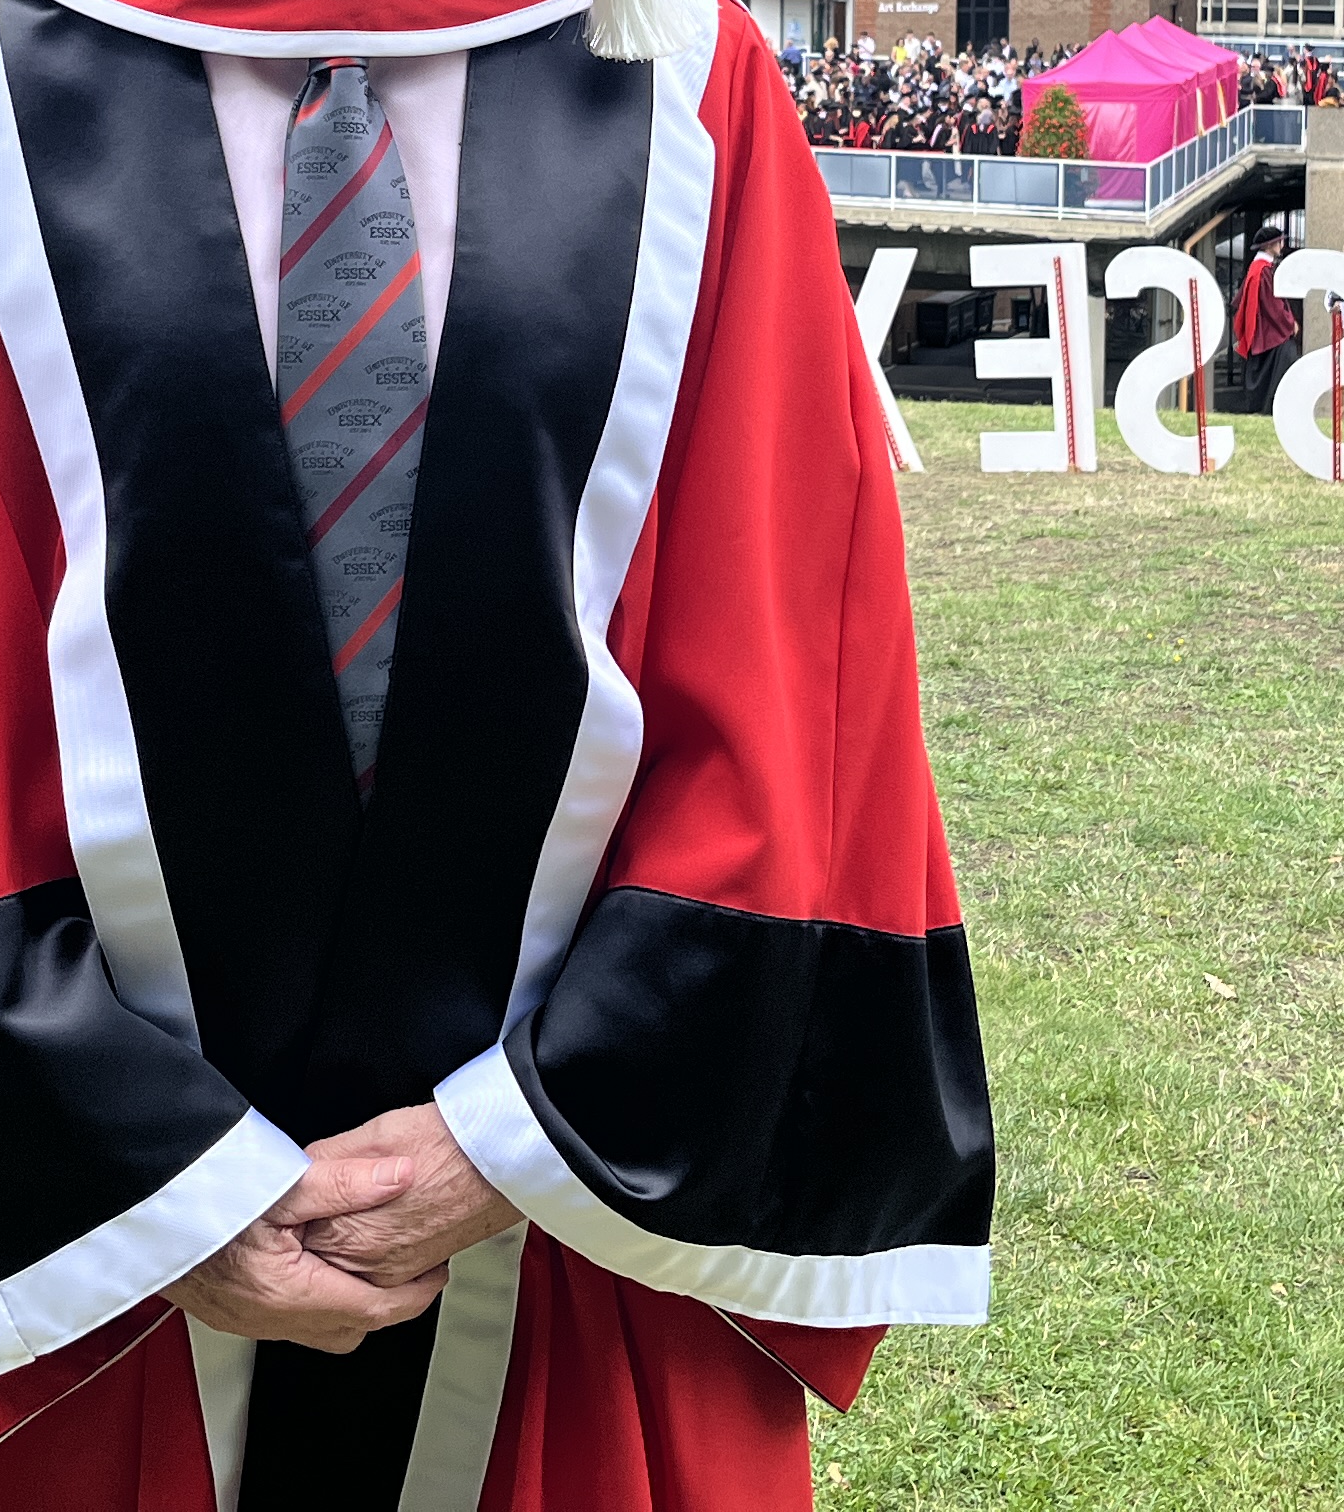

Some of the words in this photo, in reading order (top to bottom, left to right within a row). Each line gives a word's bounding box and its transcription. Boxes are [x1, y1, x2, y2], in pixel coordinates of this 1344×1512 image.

[878, 1, 894, 13] Art
[896, 1, 939, 15] Exchange
[333, 121, 369, 134] ESSEX
[297, 162, 338, 174] ESSEX
[369, 227, 410, 239] ESSEX
[334, 268, 377, 280] ESSEX
[297, 309, 341, 322] ESSEX
[375, 372, 419, 385] ESSEX
[338, 414, 382, 427] ESSEX
[302, 456, 344, 469] ESSEX
[343, 562, 387, 575] ESSEX
